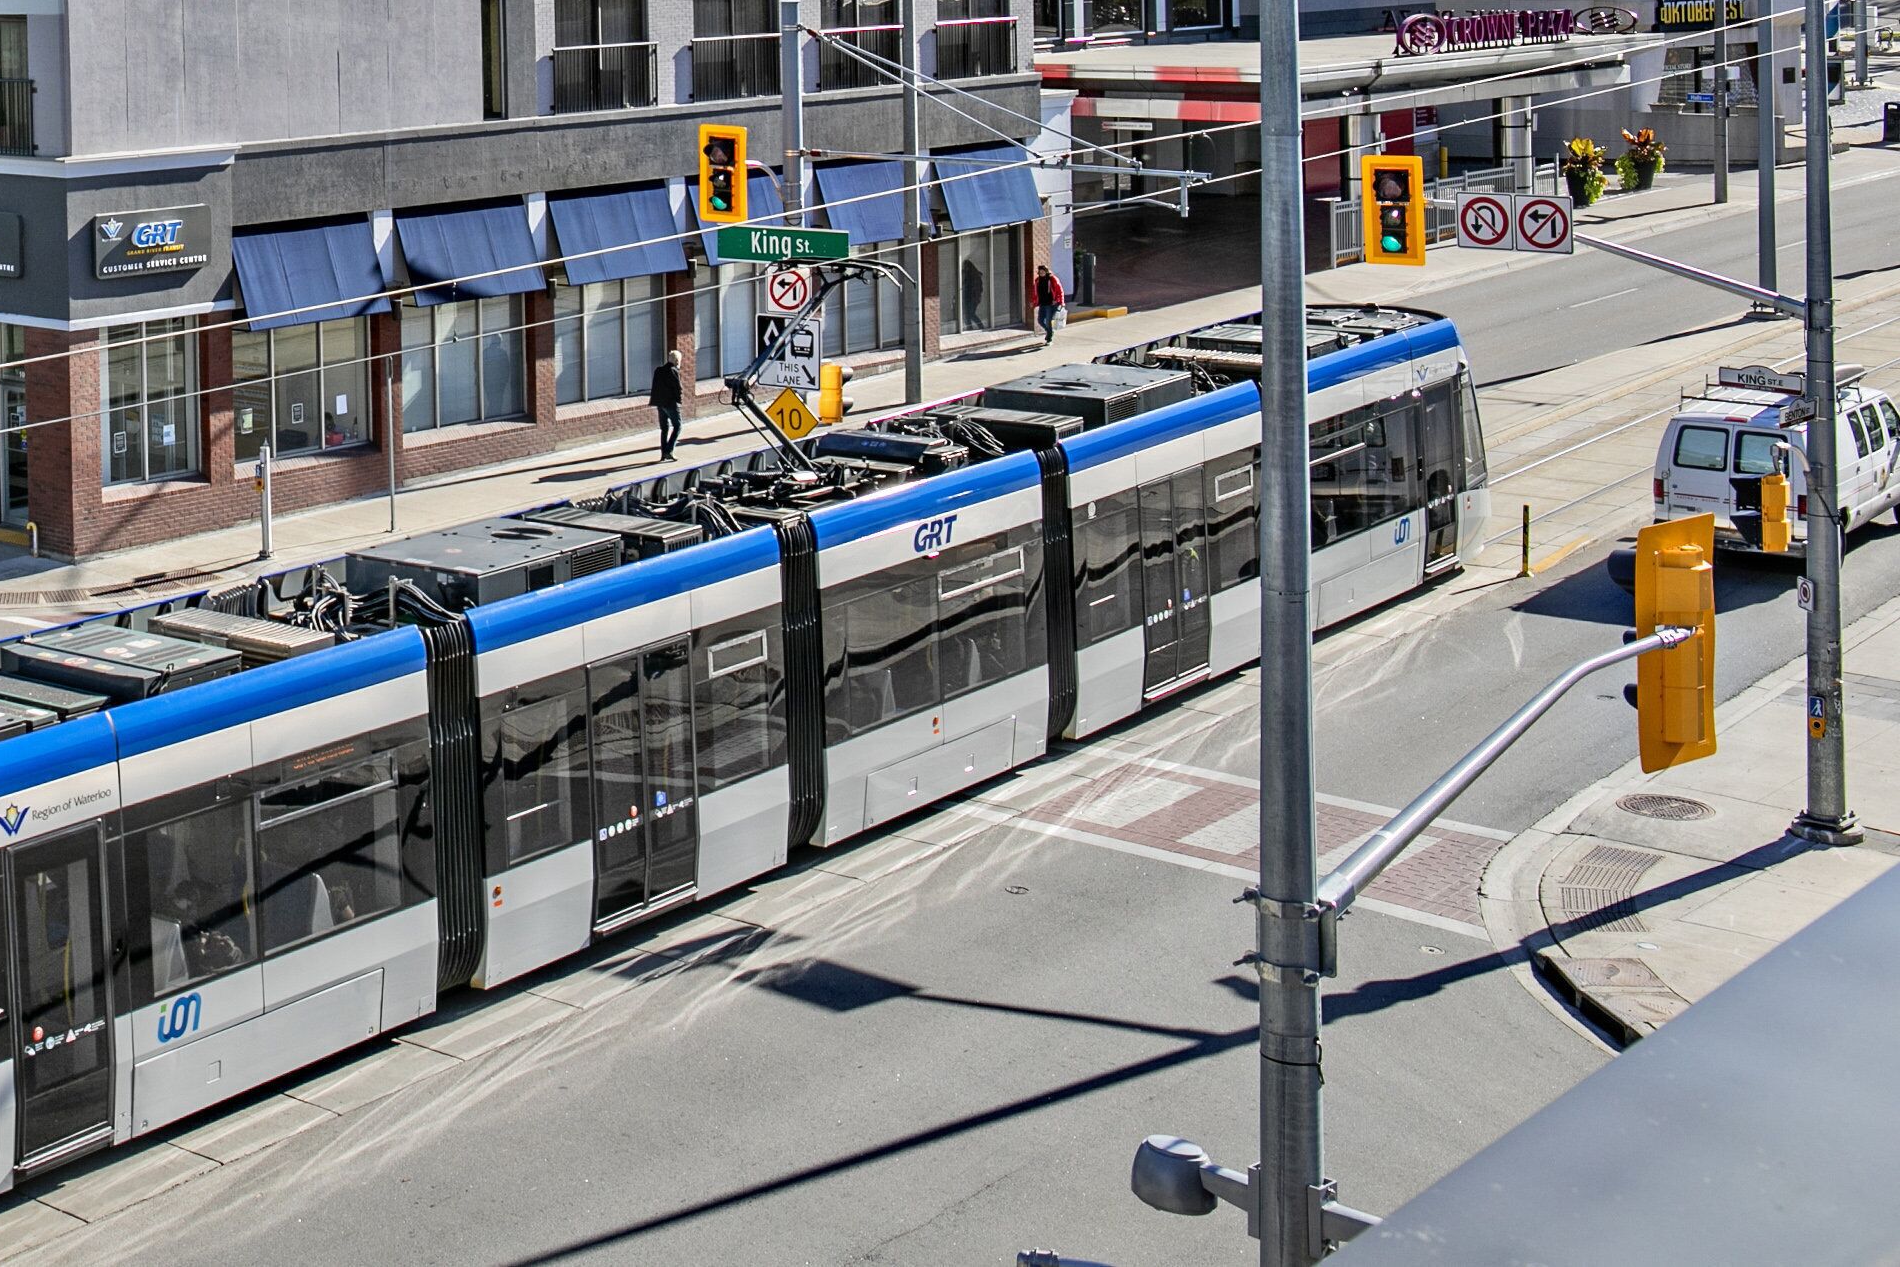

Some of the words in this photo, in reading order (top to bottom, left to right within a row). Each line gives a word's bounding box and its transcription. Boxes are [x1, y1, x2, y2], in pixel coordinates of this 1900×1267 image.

[1447, 11, 1521, 46] CROWNE
[131, 219, 183, 247] GRT
[751, 230, 792, 261] King
[796, 237, 814, 254] St.
[103, 262, 143, 273] CUSTOMER
[146, 257, 177, 269] SERVICE
[180, 254, 207, 265] CENTRE
[779, 362, 799, 373] THIS
[1737, 373, 1766, 386] KING
[776, 375, 800, 385] LANE
[777, 407, 802, 431] 10
[1785, 408, 1806, 422] BENTON
[914, 514, 957, 553] GRT
[32, 805, 61, 821] Region
[62, 798, 73, 811] of
[74, 788, 112, 807] Waterloo
